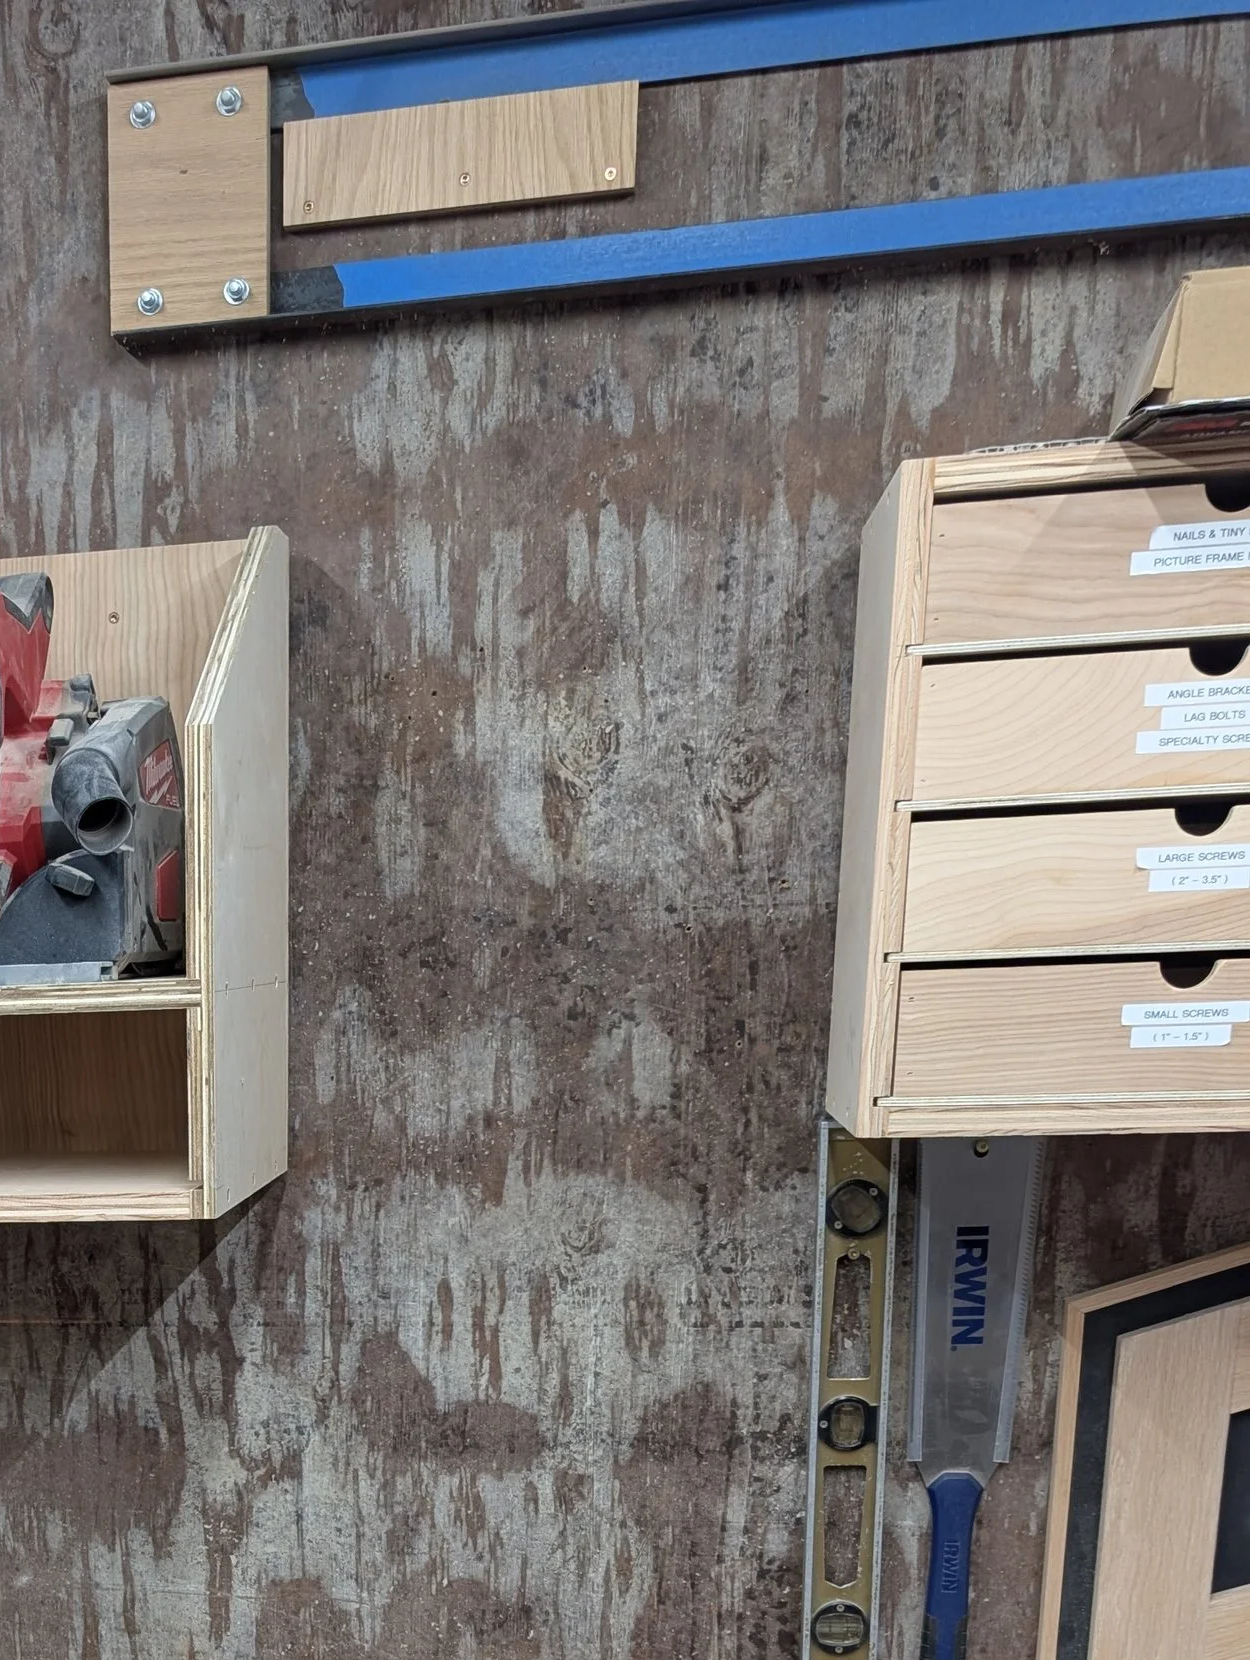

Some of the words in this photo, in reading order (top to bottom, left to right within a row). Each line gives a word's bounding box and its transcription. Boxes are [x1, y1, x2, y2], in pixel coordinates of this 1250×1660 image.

[1173, 530, 1206, 541] NAILS
[1208, 529, 1216, 539] &
[1220, 527, 1246, 538] TINY
[1153, 554, 1202, 567] PICTURE
[1205, 551, 1244, 563] FRAME
[1167, 688, 1205, 699] ANGLE
[1184, 712, 1206, 722] LAG
[1209, 710, 1246, 721] BOLTS
[1158, 735, 1219, 747] SPECIALTY
[1158, 853, 1195, 863] LARGE
[1198, 851, 1246, 861] SCREWS
[1144, 1009, 1178, 1020] SMALL
[1182, 1008, 1229, 1018] SCREWS
[951, 1226, 990, 1345] IRWIN
[941, 1541, 959, 1594] IRWIN
